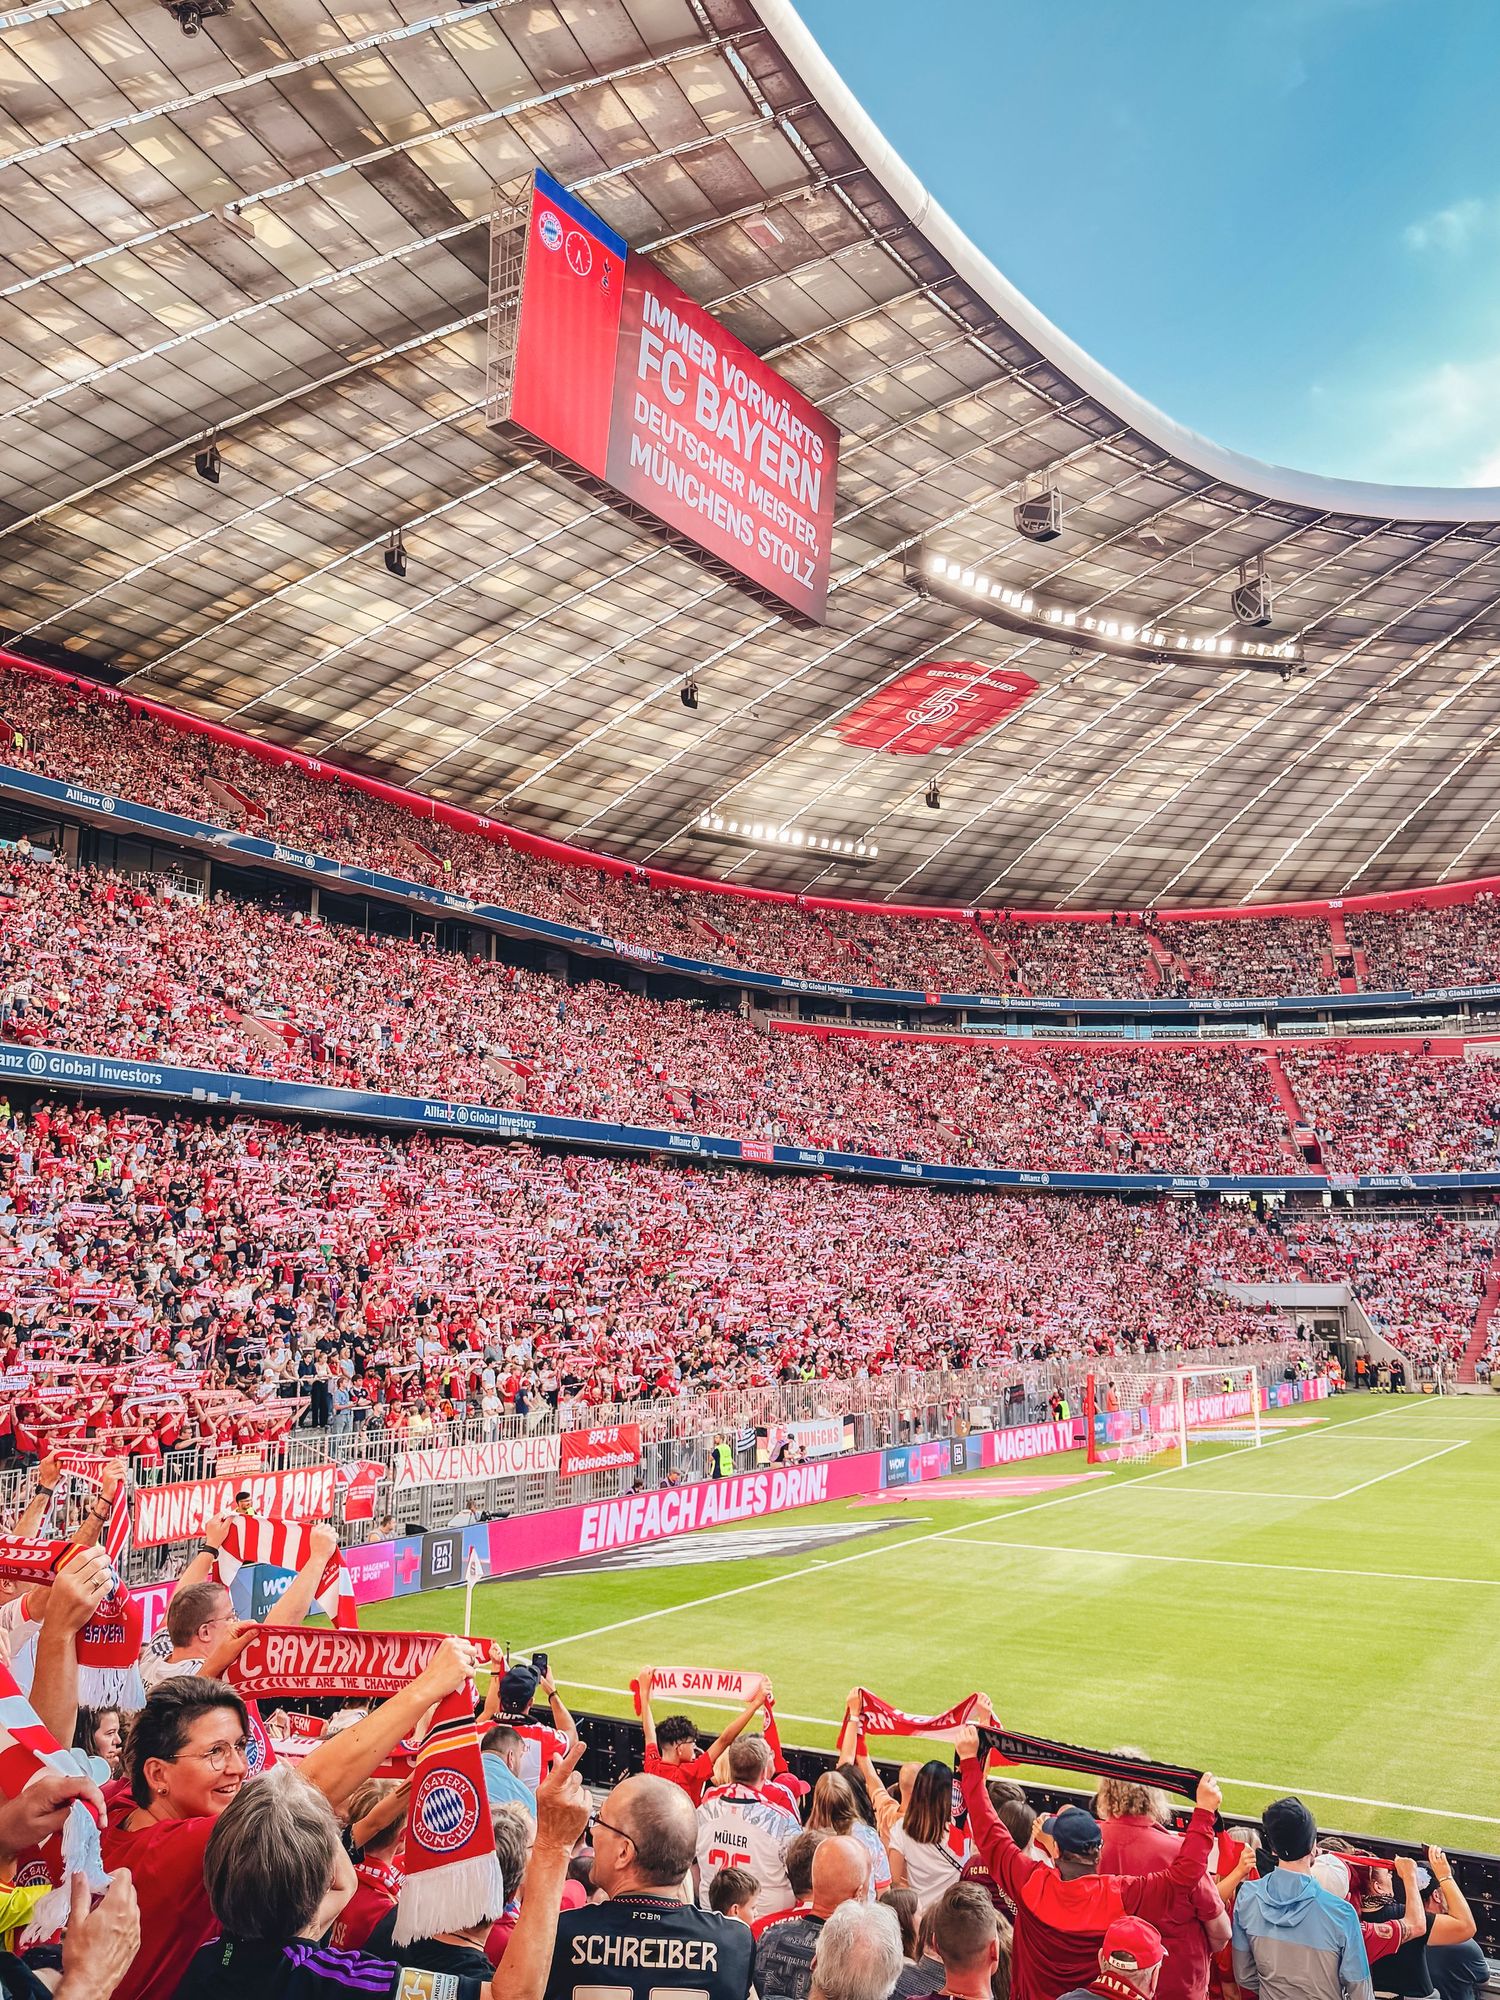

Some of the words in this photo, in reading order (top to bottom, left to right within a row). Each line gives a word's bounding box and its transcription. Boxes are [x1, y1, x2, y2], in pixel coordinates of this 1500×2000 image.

[642, 290, 717, 378] IMMER
[722, 355, 824, 464] VORWÄRTS
[637, 326, 688, 406] FC
[695, 373, 822, 514] BAYERN
[633, 392, 745, 497] DEUTSCHER
[748, 478, 820, 558] MEISTER,
[630, 433, 754, 547] MÜNCHENS
[757, 526, 817, 591] STOLZ
[905, 686, 979, 725] 5
[307, 761, 321, 773] 314
[65, 787, 101, 807] Allianz
[477, 818, 490, 829] 313
[443, 894, 466, 909] Allianz
[780, 978, 800, 989] Allianz
[808, 982, 827, 991] Global
[827, 984, 853, 995] Investors
[1448, 989, 1473, 997] Global
[979, 997, 1001, 1006] Allianz
[1010, 999, 1031, 1007] Global
[1031, 1000, 1061, 1008] Investors
[1188, 1001, 1213, 1009] Allianz
[1222, 1001, 1246, 1009] Global
[50, 1057, 96, 1078] Global
[99, 1063, 162, 1085] Investors
[469, 1110, 498, 1125] Global
[499, 1114, 537, 1129] Investors
[668, 1135, 692, 1147] Allianz
[798, 1151, 818, 1162] Allianz
[900, 1164, 916, 1174] Allianz
[1019, 1173, 1041, 1183] Allianz
[1171, 1177, 1198, 1187] Allianz
[1369, 1176, 1401, 1187] Allianz
[1159, 1403, 1175, 1429] DIE
[1199, 1396, 1225, 1421] SPORT
[1225, 1391, 1251, 1417] OPTION
[607, 1428, 619, 1443] 75
[994, 1425, 1057, 1463] MAGENTA
[1056, 1421, 1074, 1449] TV
[401, 1437, 560, 1483] ANZENKIRCHEN
[889, 1457, 906, 1470] WOW
[281, 1468, 335, 1522] PRIDE
[578, 1486, 699, 1552] EINFACH
[700, 1474, 768, 1526] ALLES
[769, 1463, 829, 1511] DRIN!
[436, 1546, 448, 1558] DA
[362, 1560, 391, 1574] MAGENTA
[436, 1556, 448, 1569] ZN
[362, 1570, 382, 1582] SPORT
[266, 1634, 373, 1676] BAYERN
[293, 1677, 311, 1689] WE
[315, 1677, 337, 1689] ARE
[342, 1677, 360, 1689] THE
[651, 1672, 677, 1690] MIA
[682, 1673, 714, 1691] SAN
[717, 1674, 743, 1693] MIA
[424, 1775, 470, 1796] BAYERN
[713, 1829, 748, 1849] MÜLLER
[970, 1866, 979, 1876] FC
[632, 1911, 662, 1921] FCBM
[570, 1934, 718, 1973] SCHREIBER
